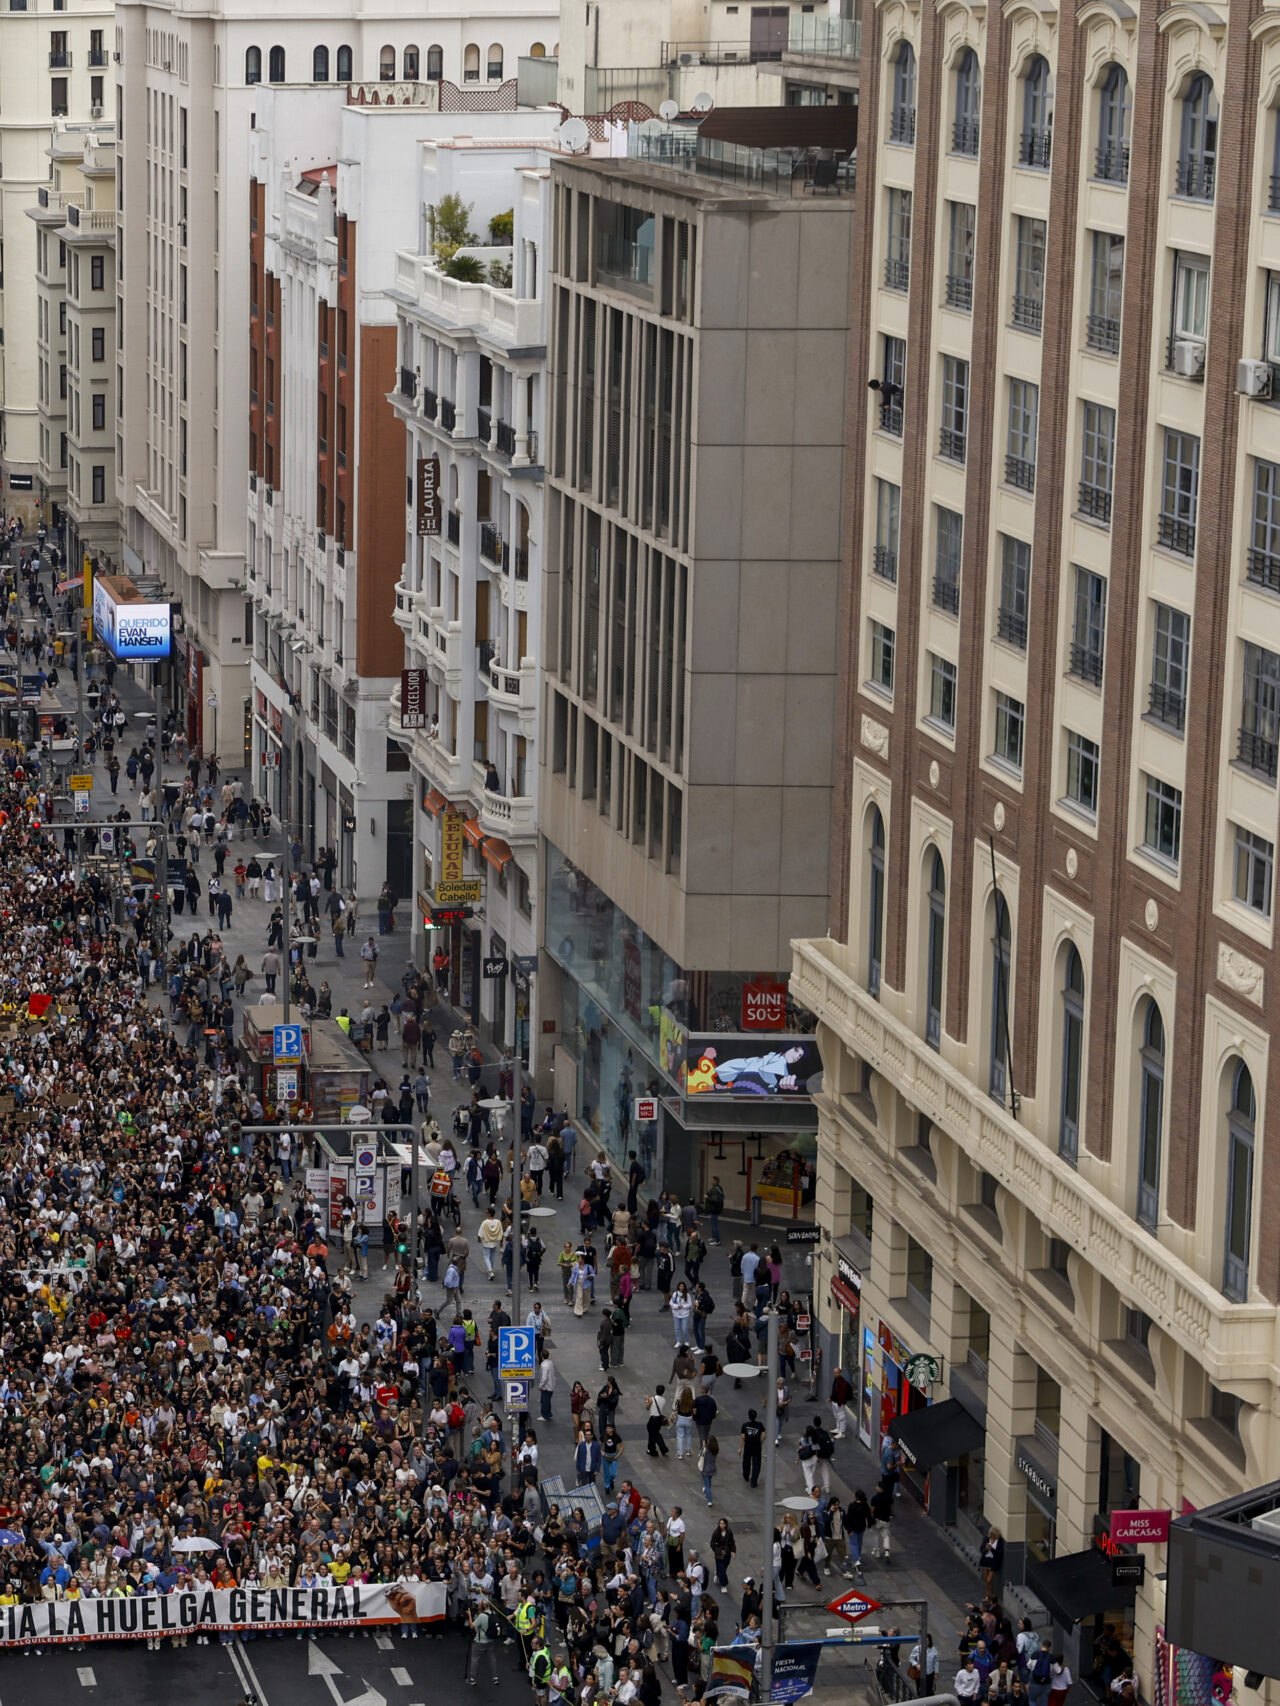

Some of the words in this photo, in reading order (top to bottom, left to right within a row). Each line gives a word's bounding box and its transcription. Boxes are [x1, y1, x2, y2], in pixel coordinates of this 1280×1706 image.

[423, 461, 434, 517] LAURIA
[119, 618, 168, 628] QUERIDO
[119, 628, 147, 637] EVAN
[119, 637, 163, 646] HANSEN
[408, 671, 420, 714] EXCELSIOR
[445, 814, 460, 880] PELUCAS
[438, 882, 478, 892] Soledad
[439, 893, 477, 901] Cabello
[747, 993, 781, 1006] MINI
[280, 1029, 297, 1053] P
[356, 1177, 371, 1194] P
[505, 1333, 529, 1363] P
[506, 1382, 524, 1403] P
[898, 1437, 917, 1465] STARBUCKS
[1018, 1457, 1051, 1498] STARBUCKS
[1130, 1519, 1150, 1527] MISS
[1116, 1528, 1162, 1537] CARCASAS
[48, 1600, 84, 1637] LA
[97, 1591, 217, 1633] HUELGA
[229, 1586, 368, 1624] GENERAL
[842, 1603, 867, 1612] Metro
[13, 1636, 59, 1646] ALQUILER
[61, 1635, 80, 1643] 50%
[90, 1629, 161, 1640] EXPROPIACIÓN
[201, 1622, 234, 1631] BUITRE
[245, 1621, 300, 1630] CONTRATOS
[301, 1619, 362, 1628] INDEFINIDOS
[774, 1664, 807, 1674] NACIONAL
[775, 1658, 795, 1667] FIESTA
